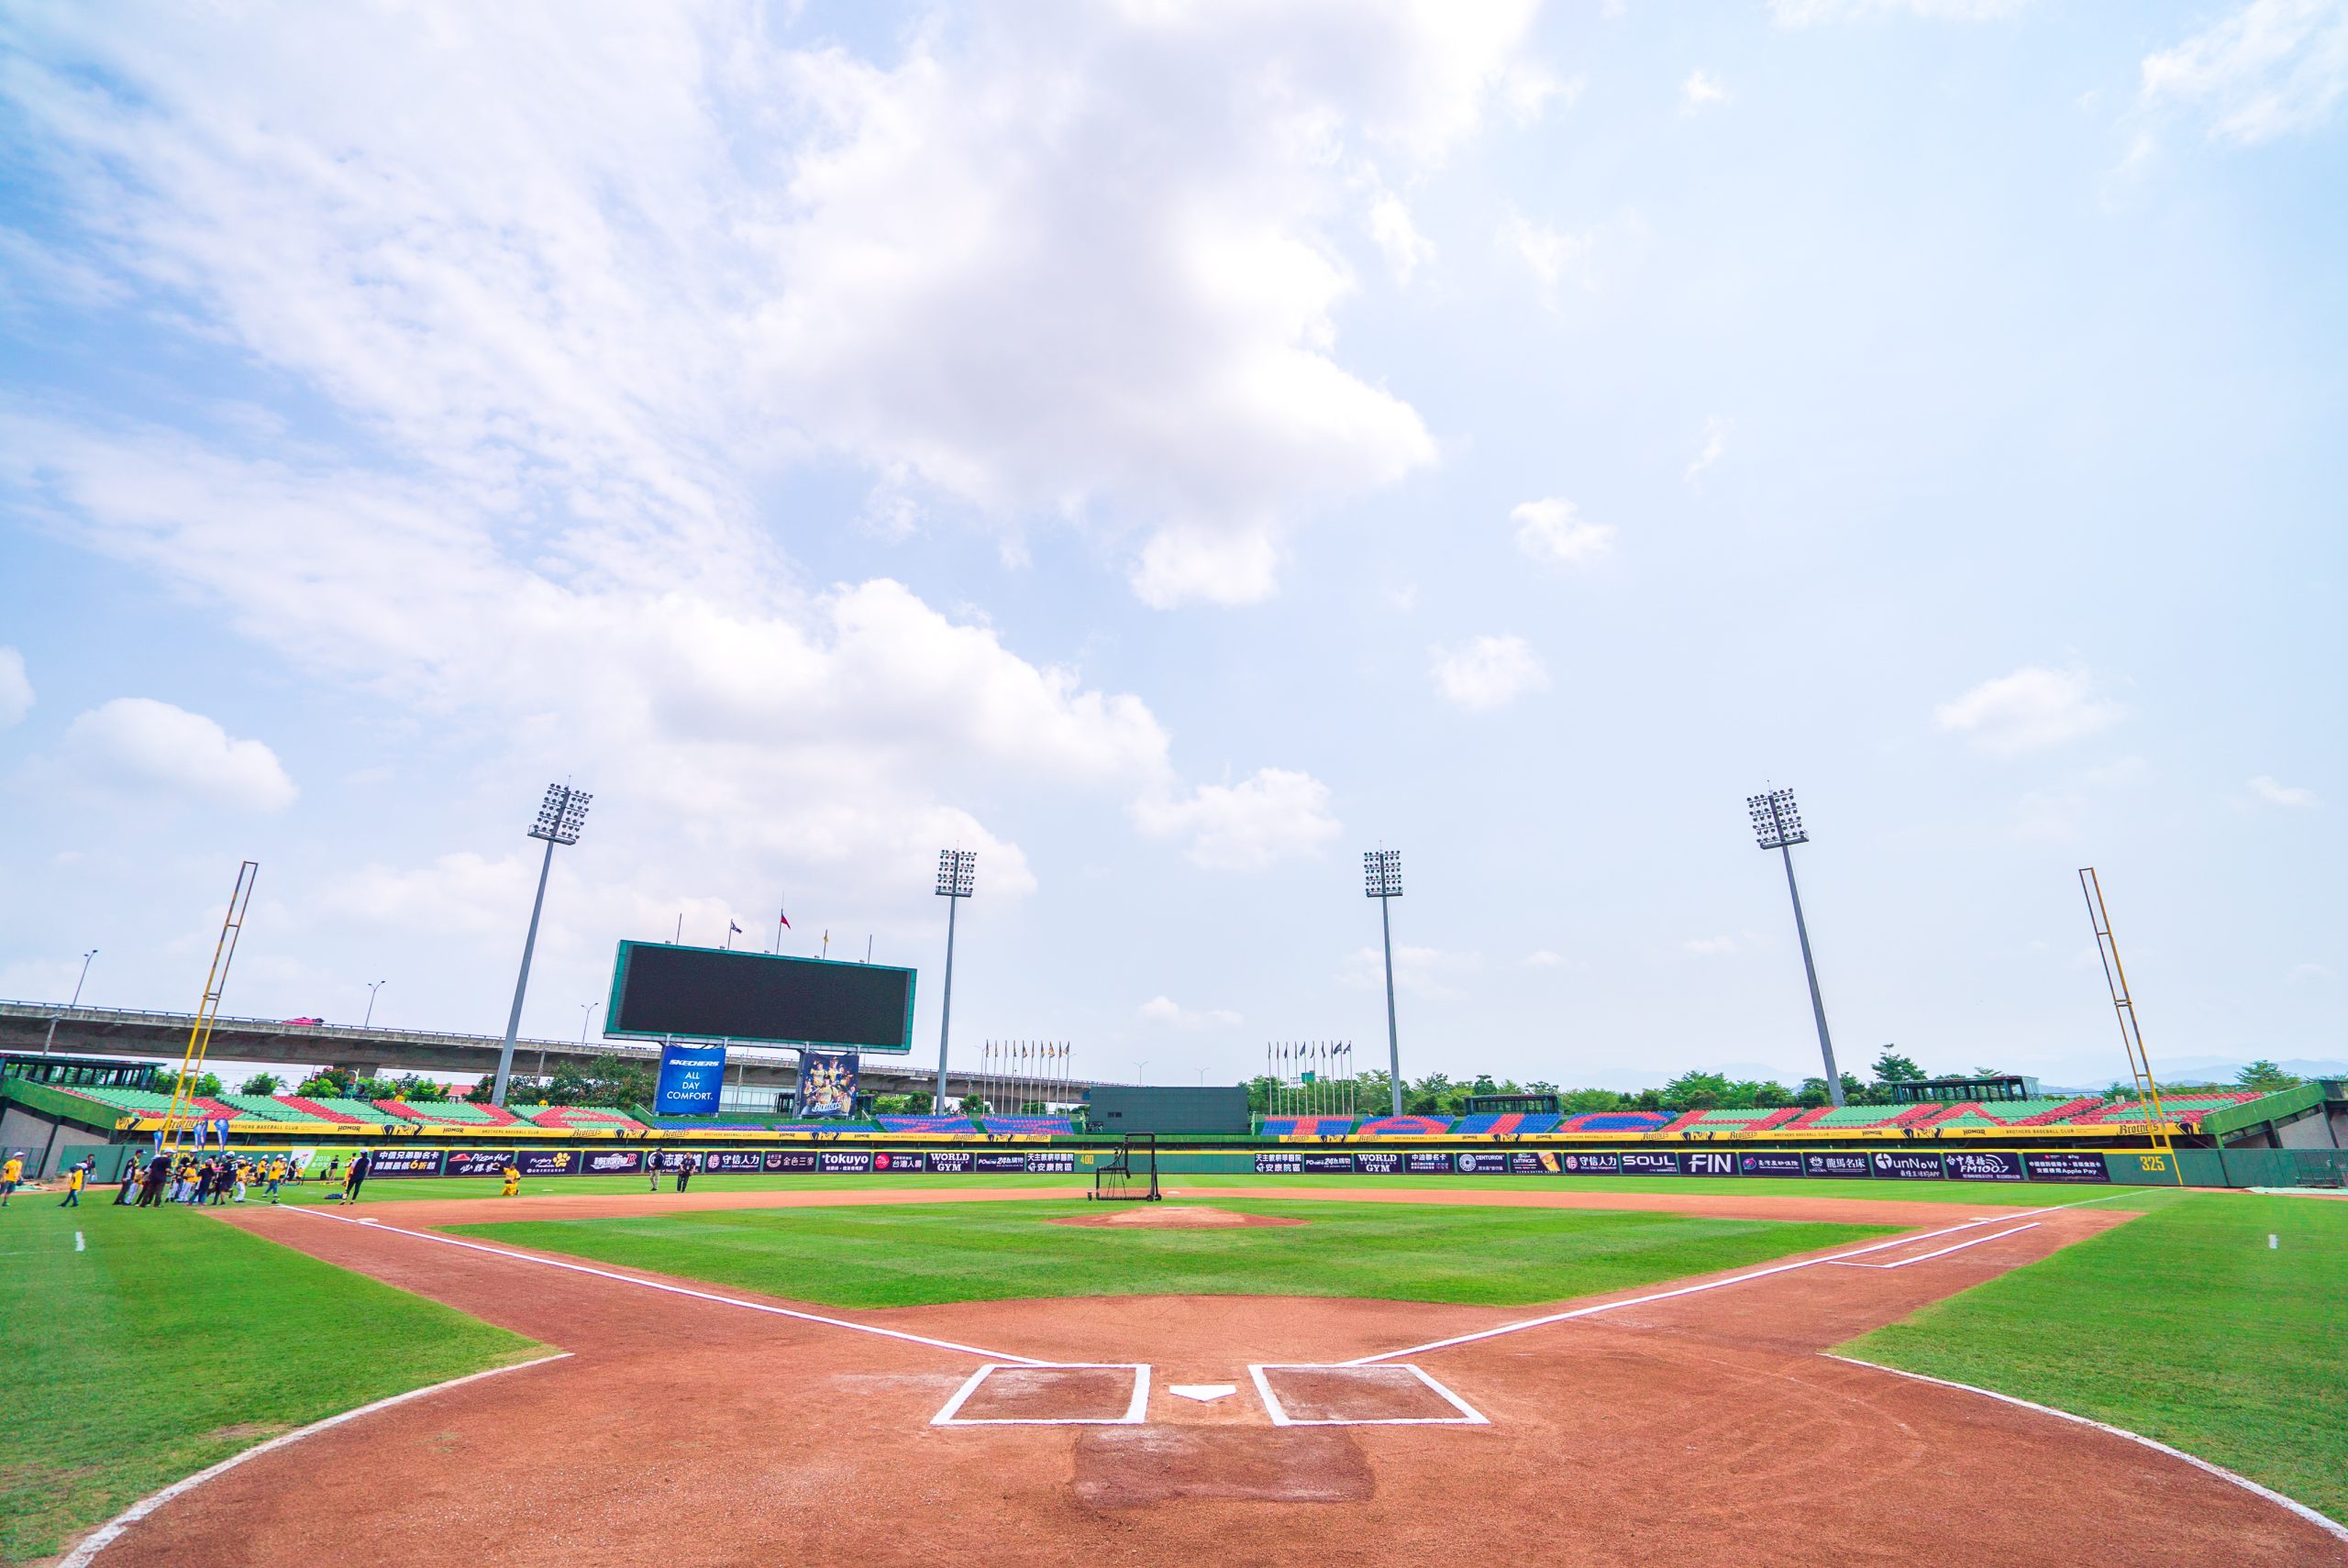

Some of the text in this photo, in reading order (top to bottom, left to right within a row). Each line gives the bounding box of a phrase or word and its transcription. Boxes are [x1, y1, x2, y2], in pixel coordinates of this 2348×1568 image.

[669, 1059, 720, 1067] SKECHERS
[684, 1071, 700, 1079] ALL
[681, 1081, 700, 1089] DAY
[666, 1091, 714, 1100] COMFORT.
[2116, 1123, 2159, 1135] Brothes
[471, 1153, 512, 1162] Pizza Hut
[722, 1154, 759, 1165] 守信人力
[825, 1154, 869, 1165] tokuyo
[930, 1153, 970, 1161] WORLD
[1080, 1154, 1094, 1165] 400
[1357, 1154, 1398, 1162] WORLD
[1579, 1155, 1617, 1165] 守信人力
[1623, 1154, 1676, 1165] SOUL
[1688, 1154, 1732, 1173] FIN
[1826, 1157, 1866, 1168] 龍馬名床
[2139, 1156, 2165, 1171] 325
[936, 1164, 962, 1172] GYM
[1037, 1163, 1072, 1172] 安康院區
[1265, 1164, 1301, 1173] 安康院區
[1366, 1165, 1390, 1173] GYM
